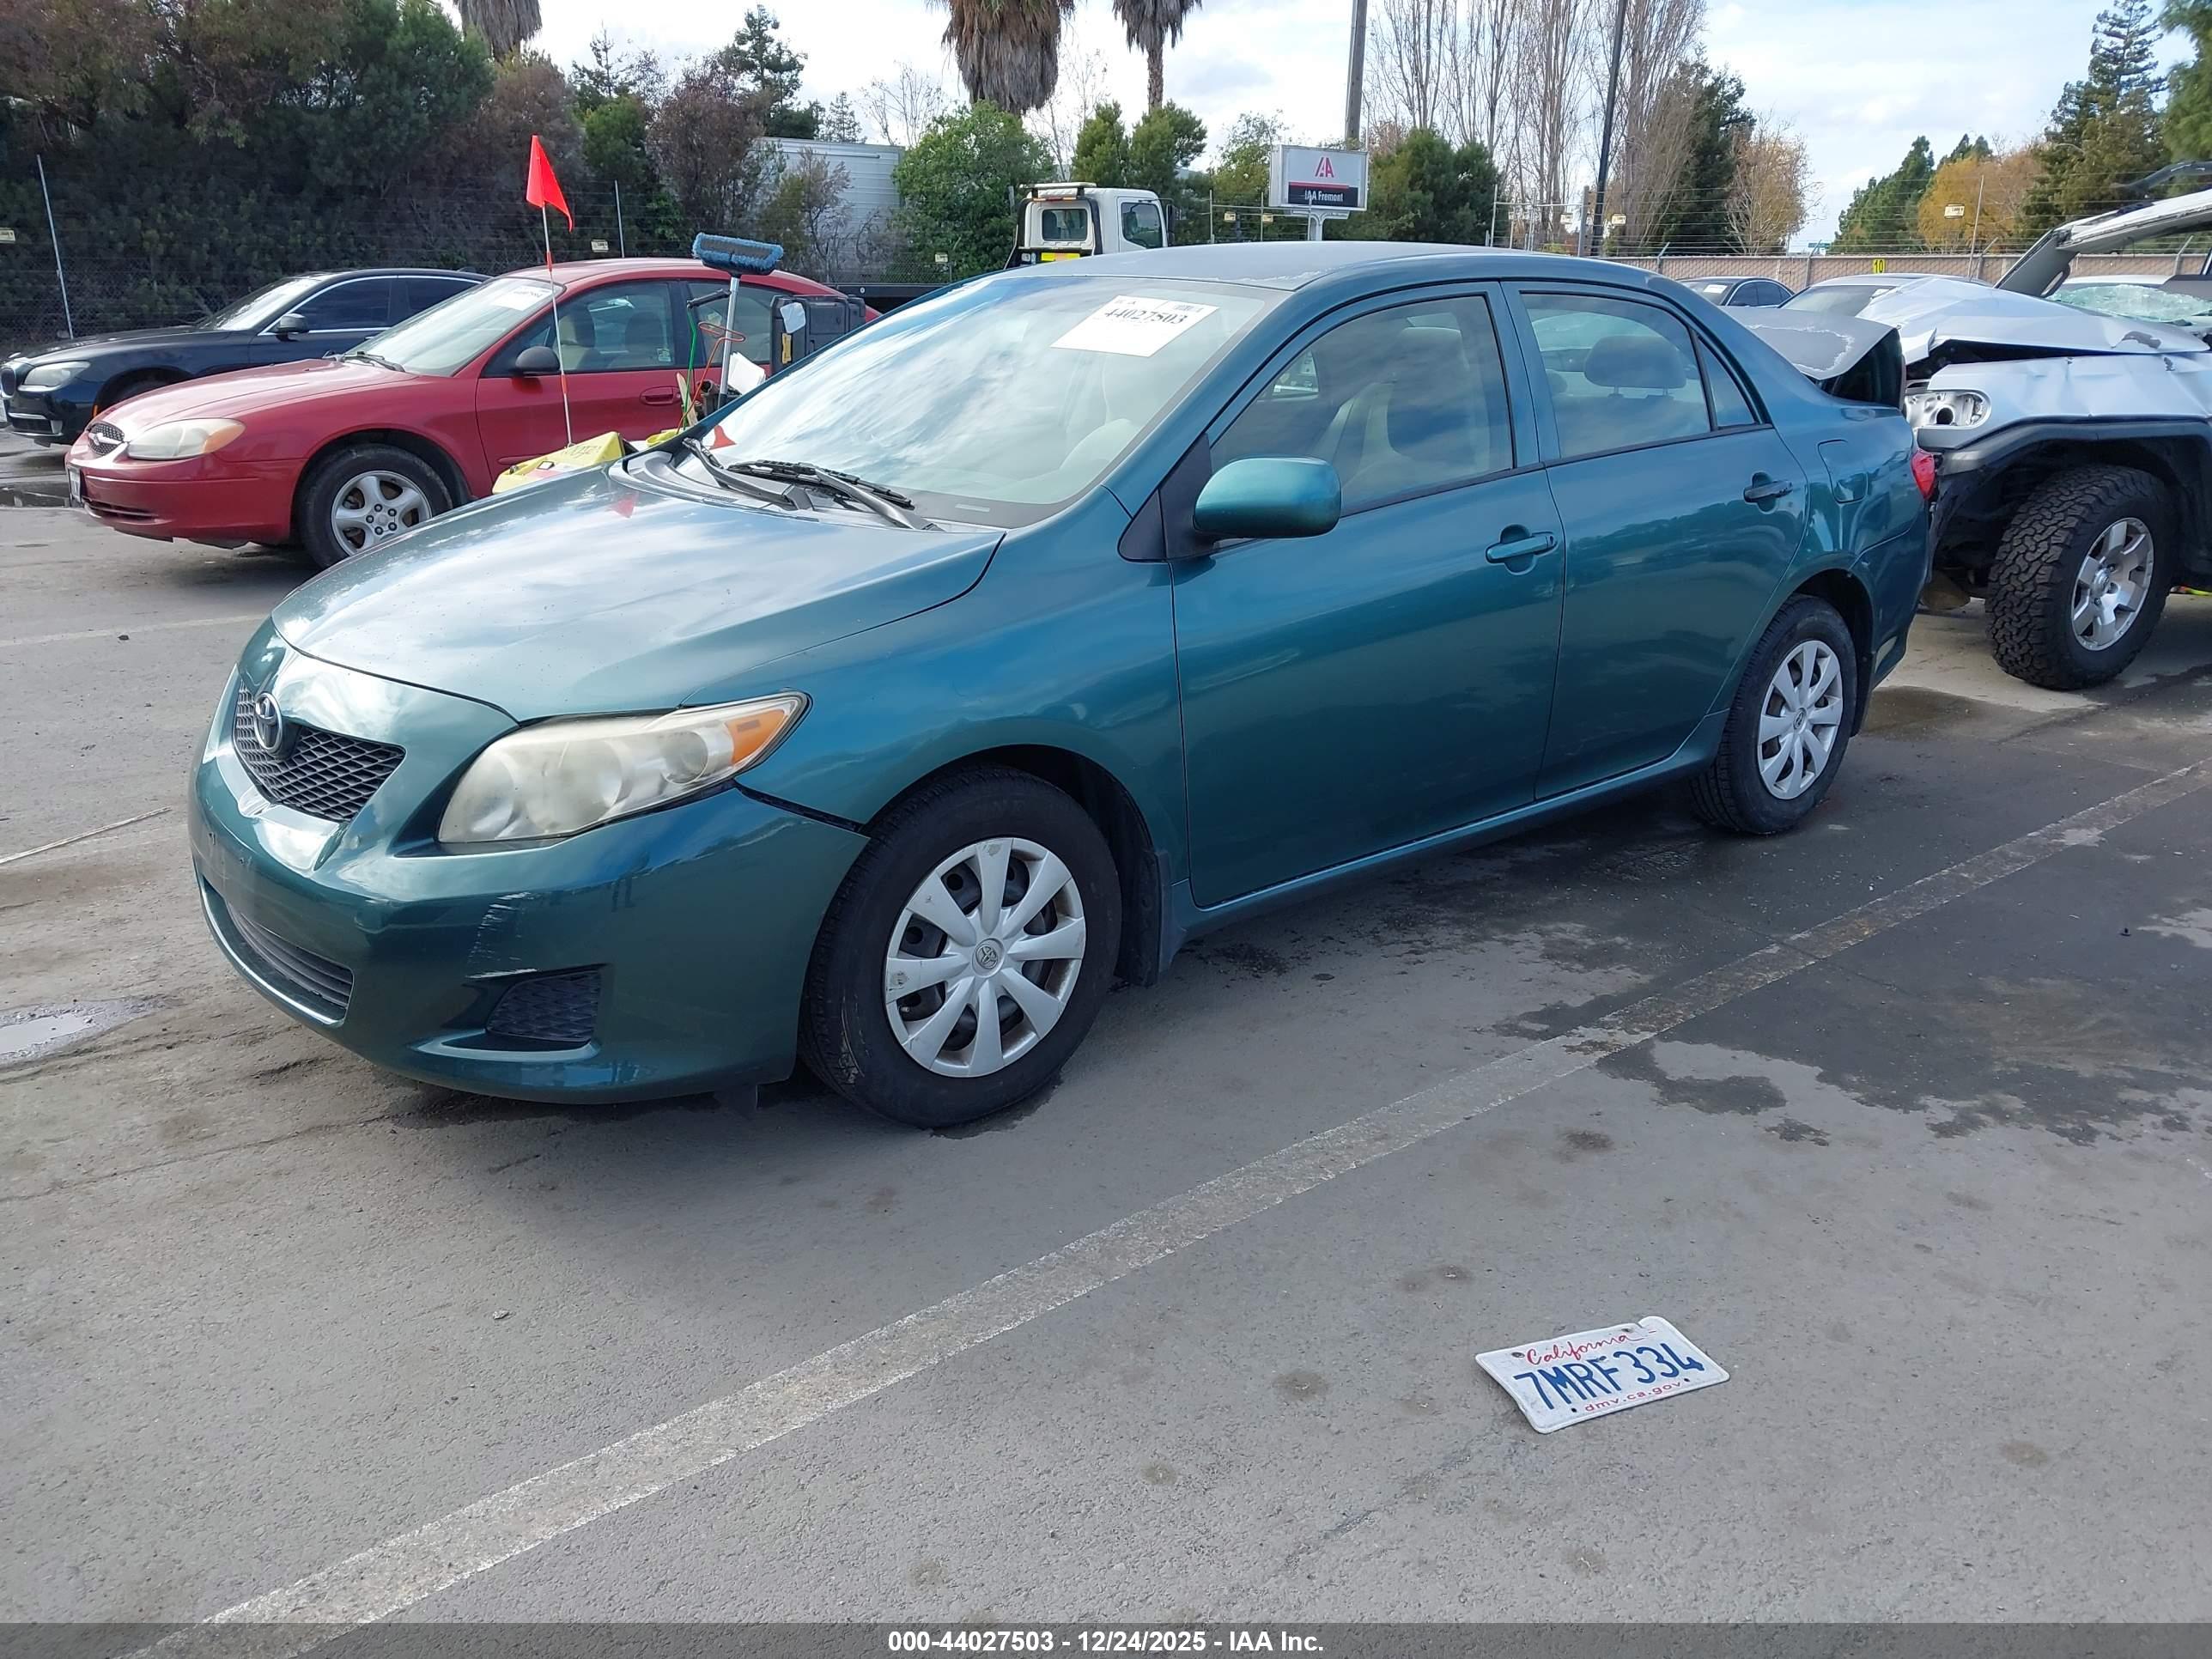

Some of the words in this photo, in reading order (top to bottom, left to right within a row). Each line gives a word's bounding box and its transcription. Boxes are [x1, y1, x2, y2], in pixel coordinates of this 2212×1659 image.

[1304, 189, 1317, 201] IAA
[1318, 191, 1344, 203] Fremont
[1874, 259, 1884, 273] 10
[1104, 307, 1188, 325] 44027503
[1526, 1332, 1638, 1366] California
[1513, 1343, 1705, 1410] 7MRF334
[1584, 1380, 1682, 1413] dmv.ca.gov
